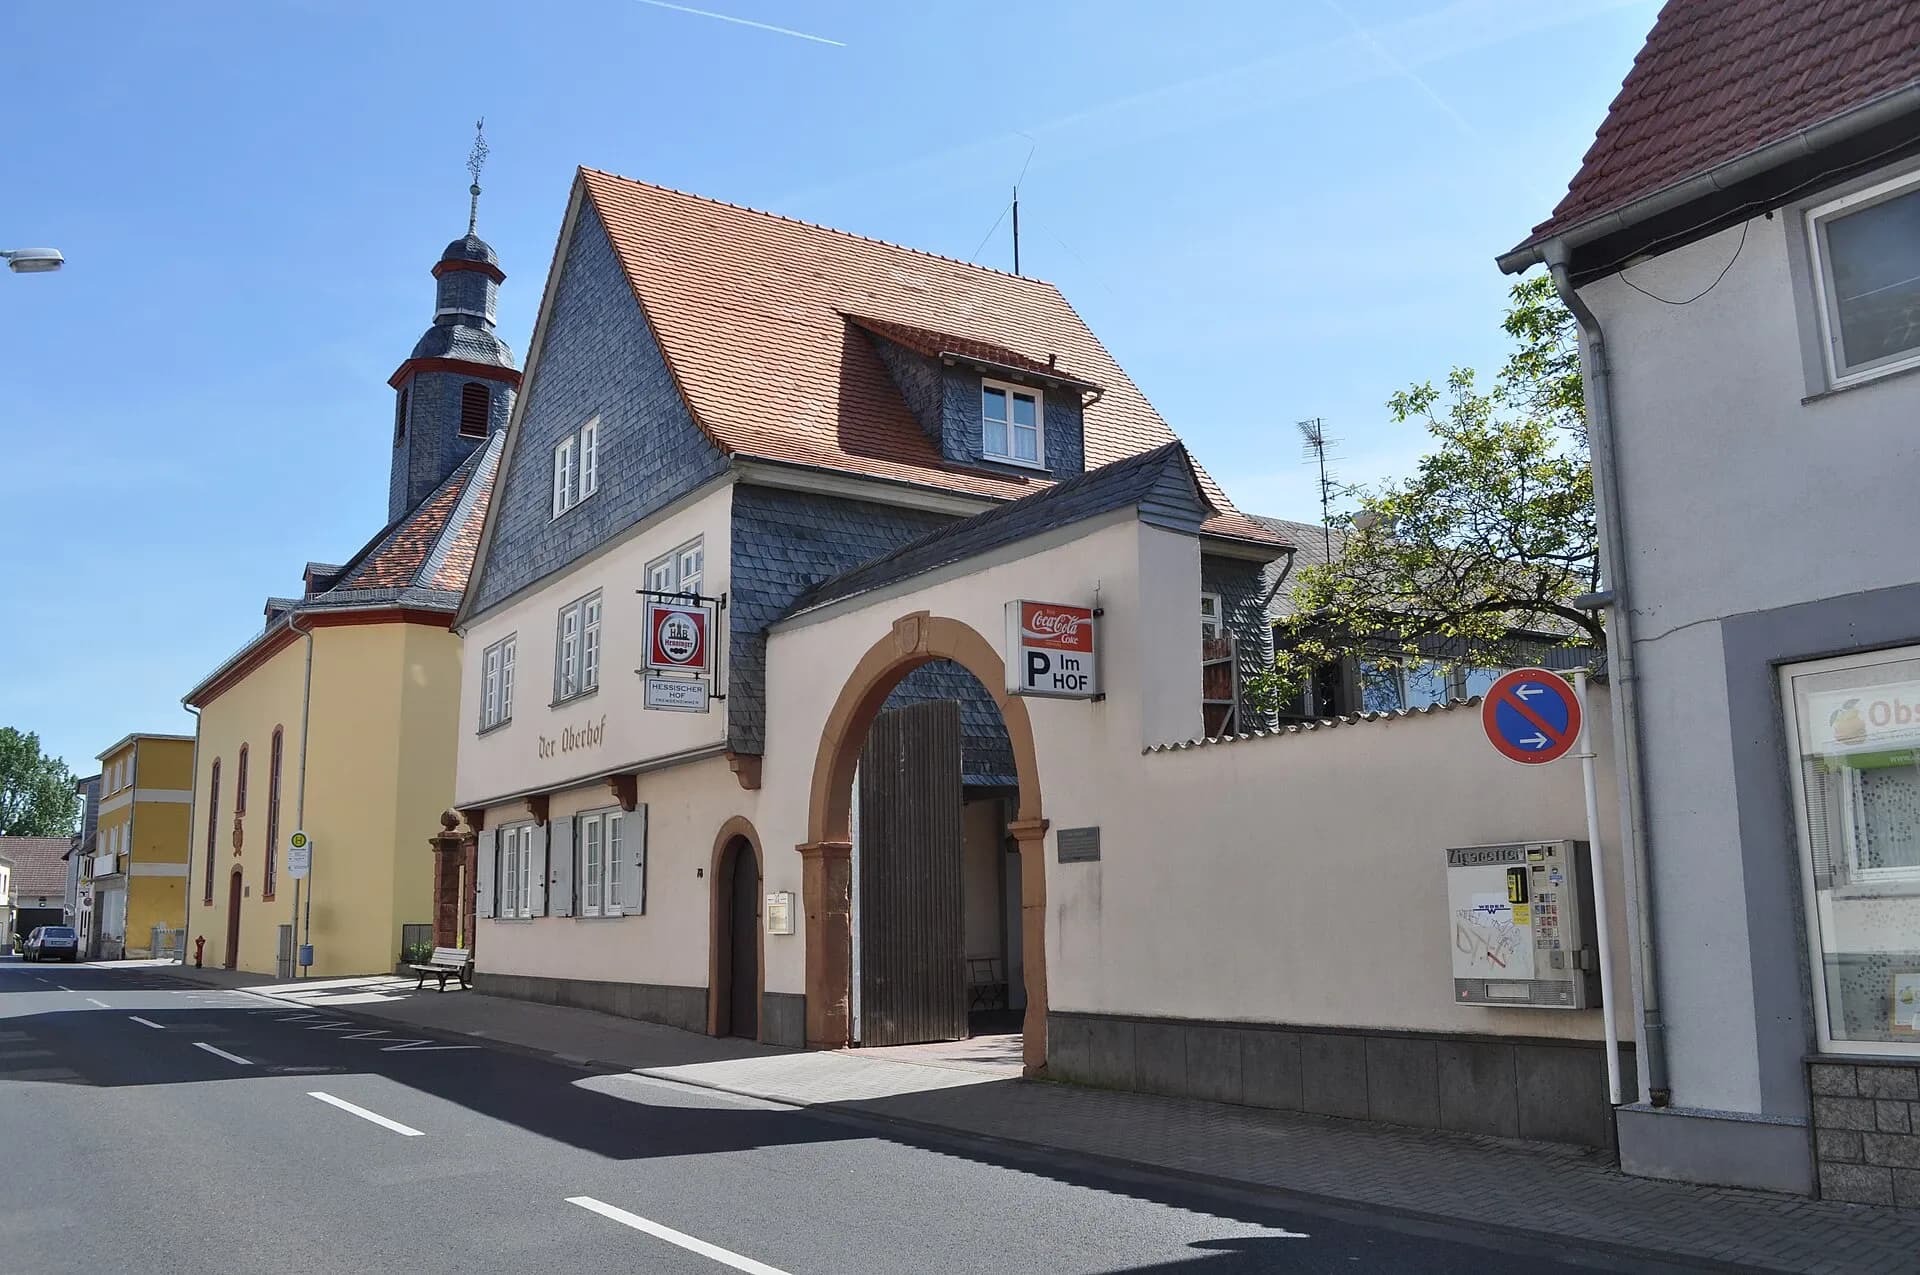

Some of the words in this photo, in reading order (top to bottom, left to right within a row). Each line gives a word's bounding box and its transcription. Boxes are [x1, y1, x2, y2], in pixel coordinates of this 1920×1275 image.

[1032, 609, 1080, 634] Coca-Cola
[1061, 634, 1079, 645] Coke
[1027, 650, 1051, 687] P
[1060, 654, 1080, 671] Im
[652, 684, 702, 693] HESSISCHER
[1053, 672, 1088, 691] HOF
[538, 734, 556, 760] Der
[561, 712, 607, 753] Oberhof
